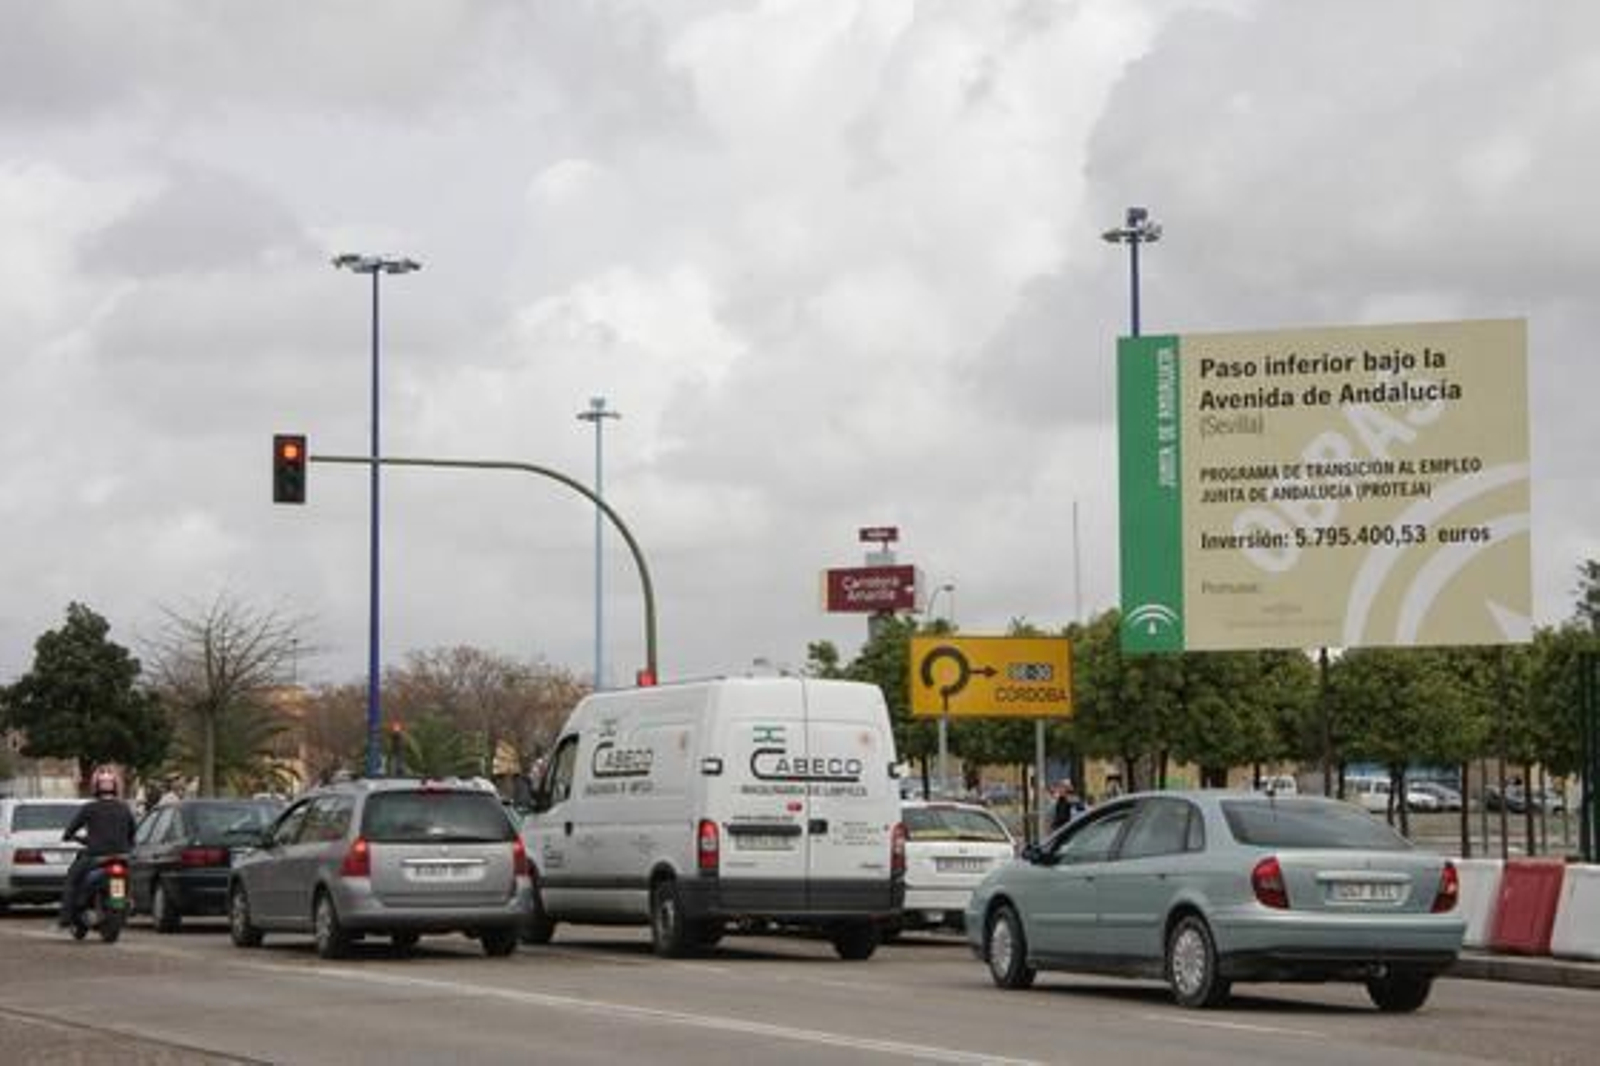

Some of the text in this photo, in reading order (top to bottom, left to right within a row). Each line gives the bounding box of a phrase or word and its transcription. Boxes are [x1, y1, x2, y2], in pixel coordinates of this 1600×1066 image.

[1200, 347, 1445, 379] Paso inferior bajo la
[1199, 379, 1462, 411] Avenida de Andalucía
[1200, 457, 1482, 482] PROGRAMA DE TRANSICIÓN AL EMPLEO
[1200, 486, 1245, 503] JUNTA
[1249, 486, 1268, 502] DE
[1356, 480, 1432, 502] (PROTEJA)
[1200, 524, 1492, 550] Inversión: 5.795.400,53 euros
[750, 747, 863, 783] CABECO
